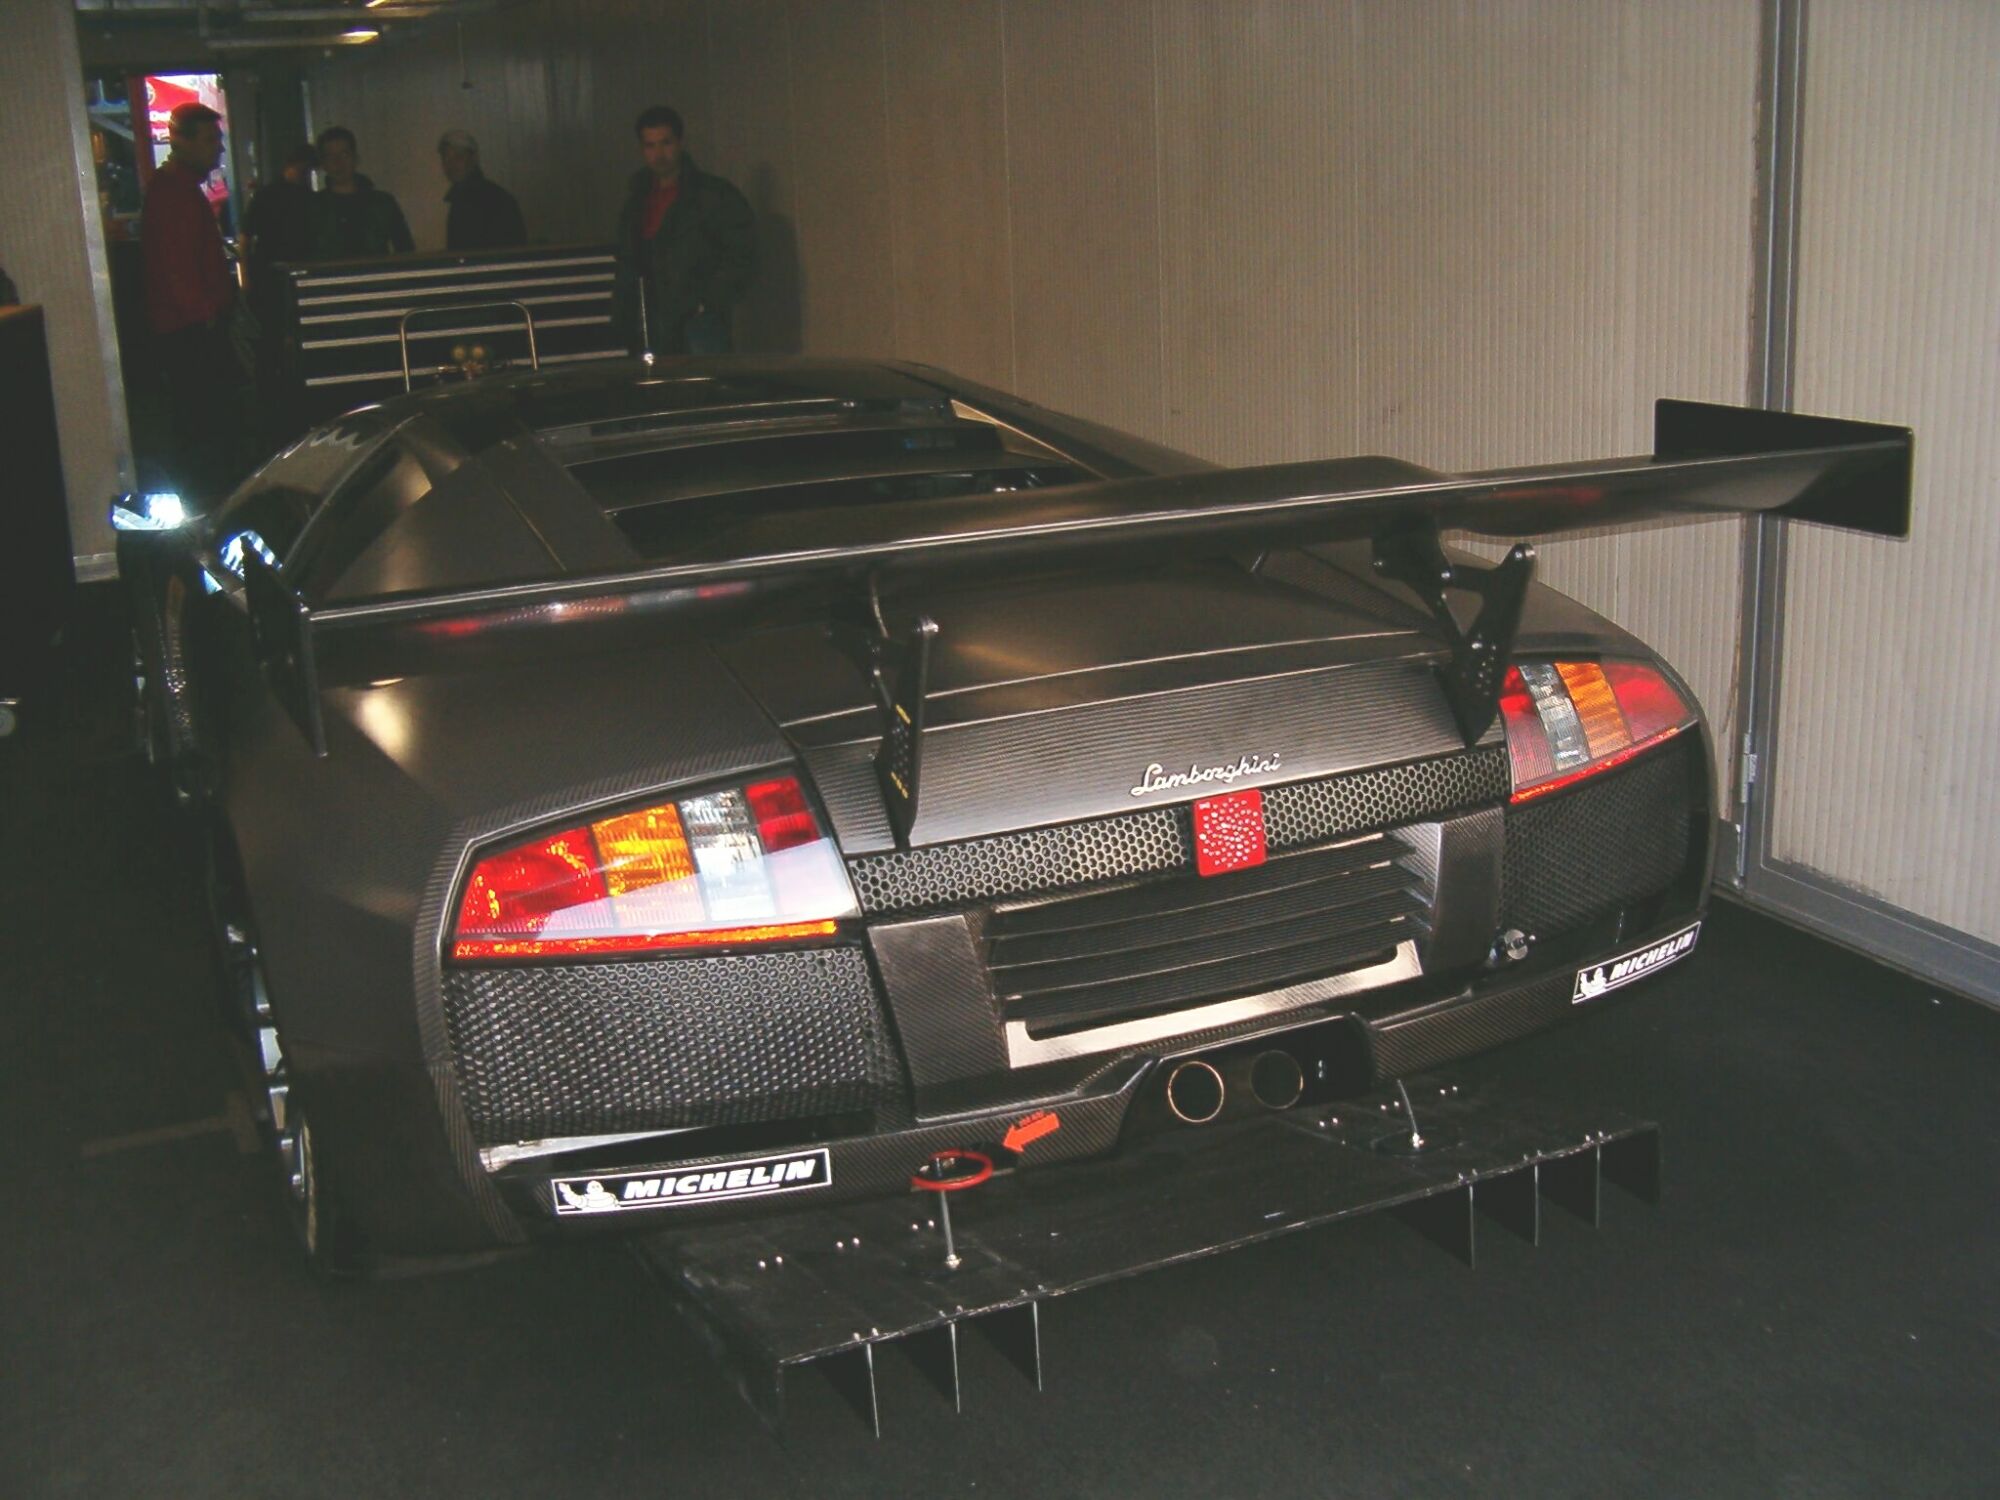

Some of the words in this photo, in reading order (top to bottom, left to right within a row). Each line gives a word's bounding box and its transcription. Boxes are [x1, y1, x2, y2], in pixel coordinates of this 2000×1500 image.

[1131, 752, 1282, 796] Lamborghini
[1611, 931, 1694, 979] MICHELIN
[624, 1159, 816, 1199] MICHELIN
